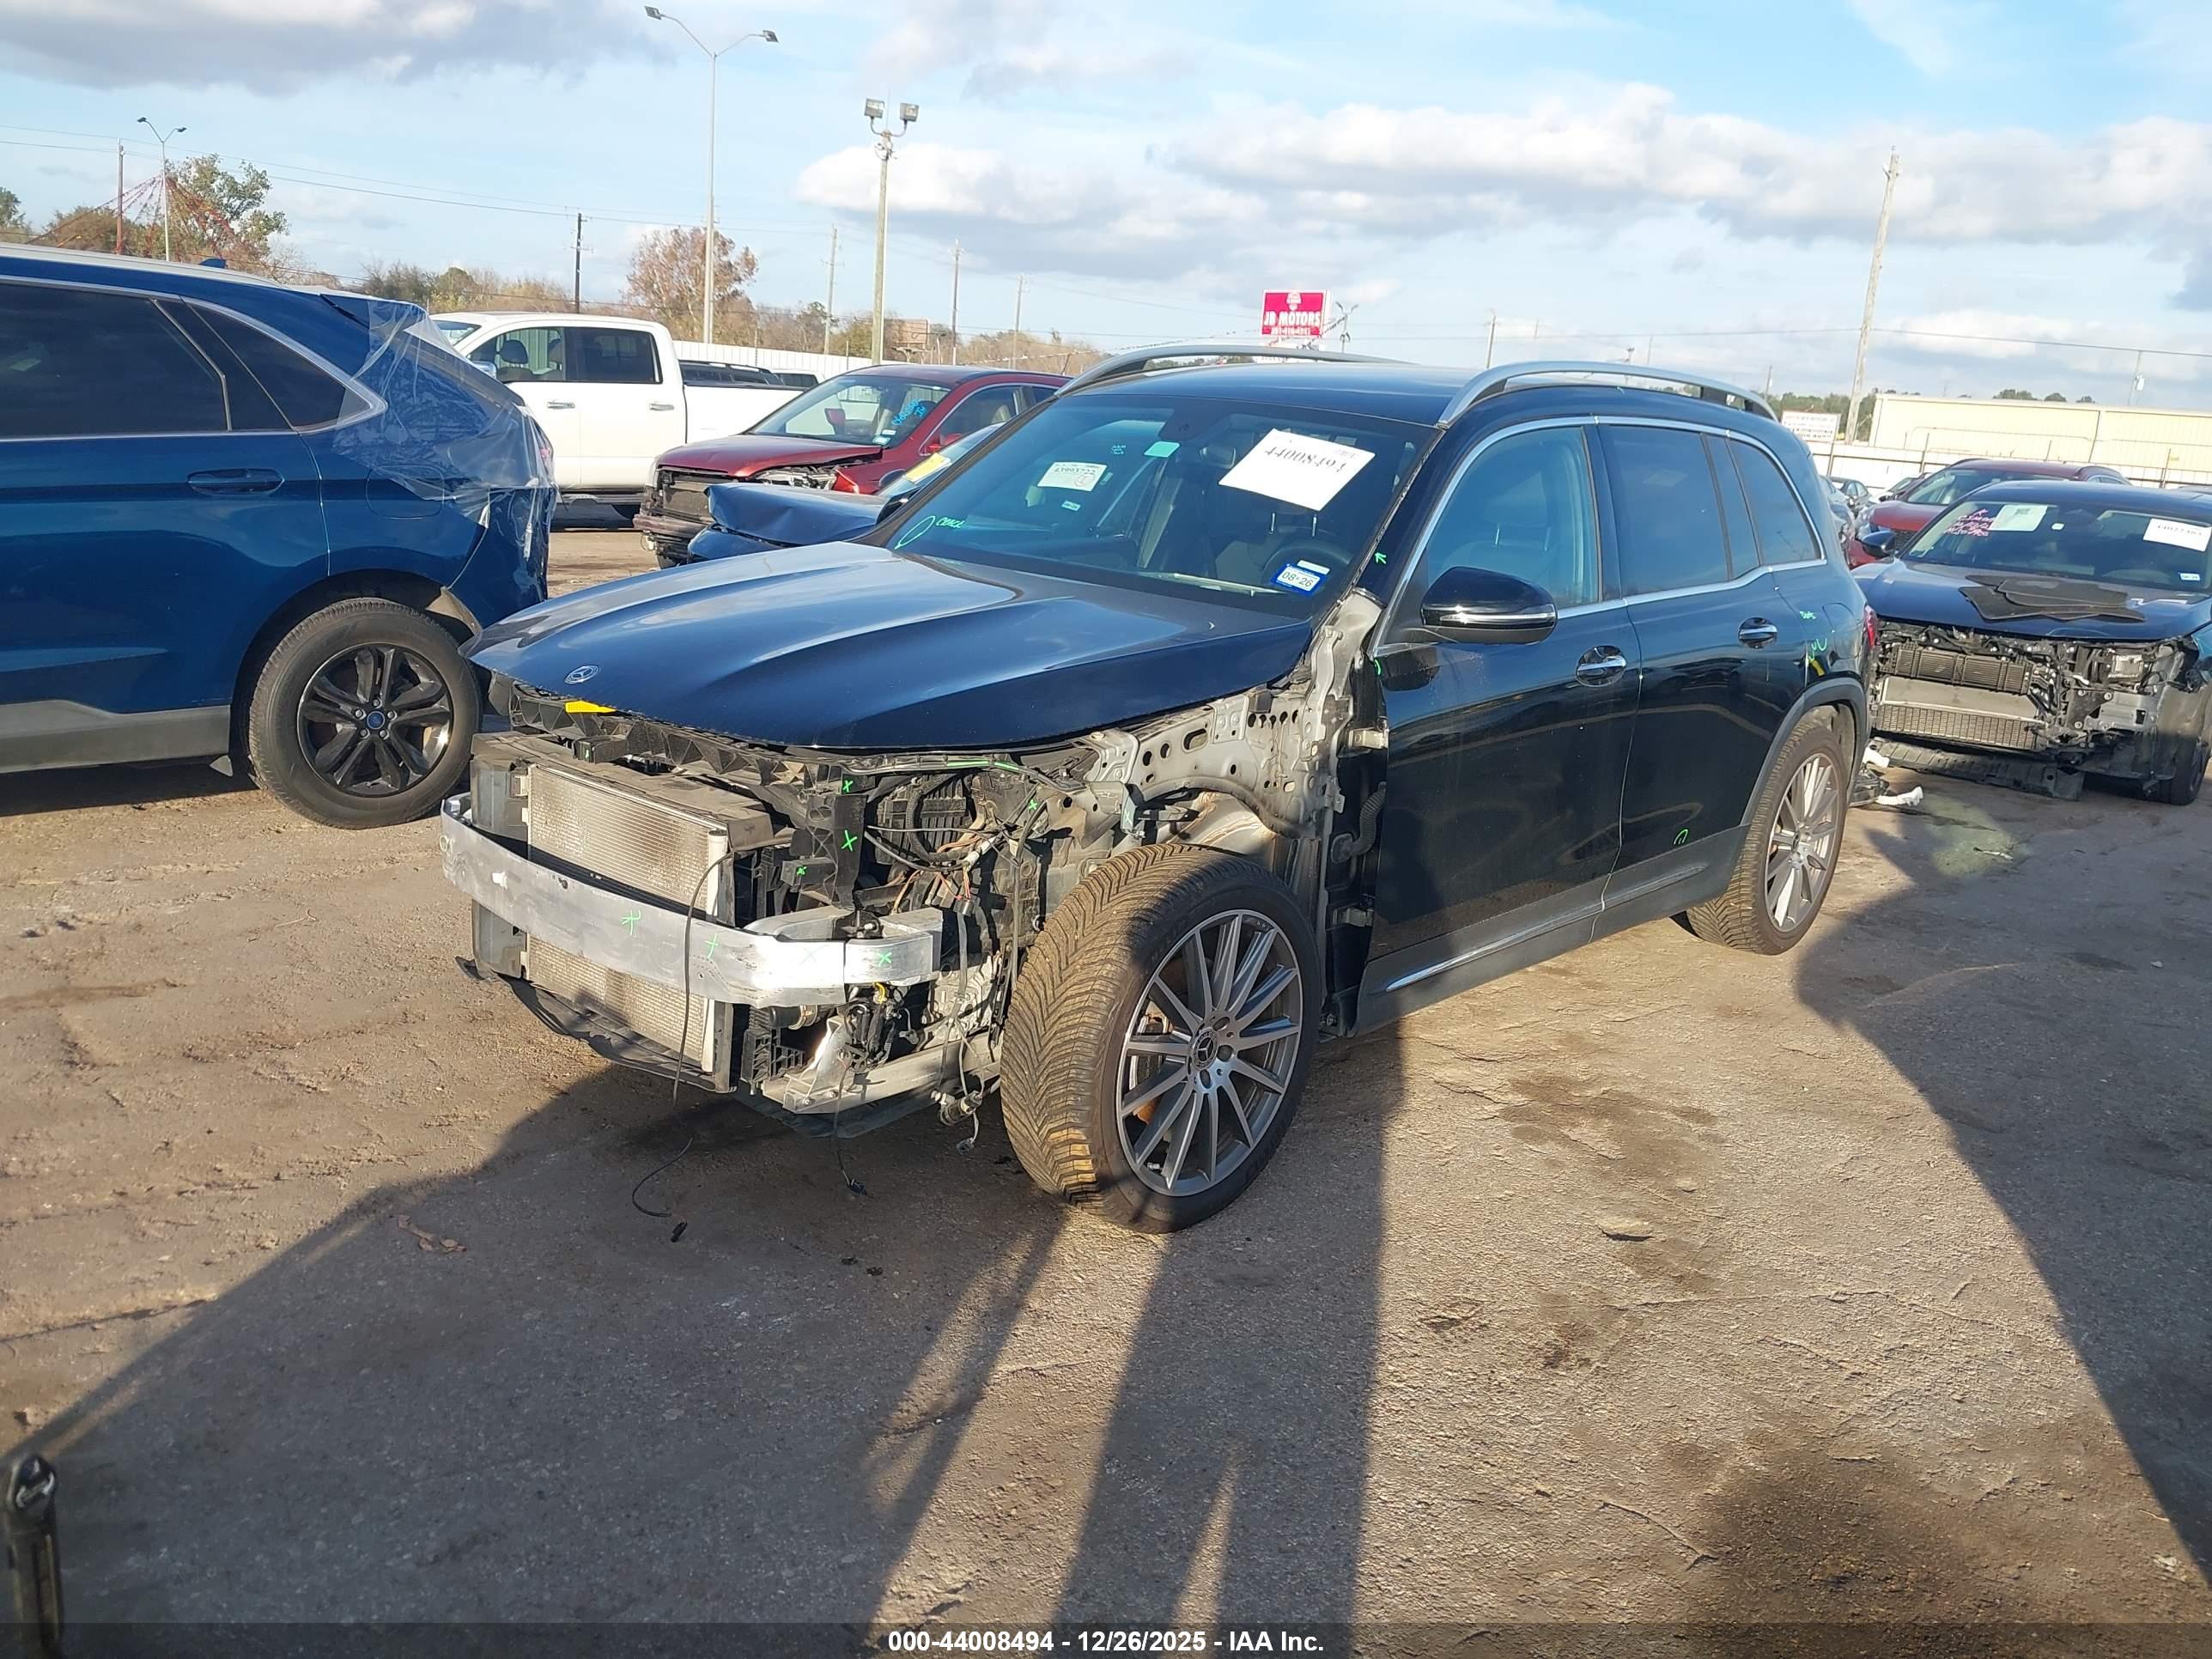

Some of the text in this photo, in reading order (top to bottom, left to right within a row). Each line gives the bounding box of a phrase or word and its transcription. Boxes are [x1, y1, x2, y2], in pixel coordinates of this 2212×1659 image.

[1279, 311, 1321, 326] MOTORS
[1281, 571, 1314, 587] 08 26
